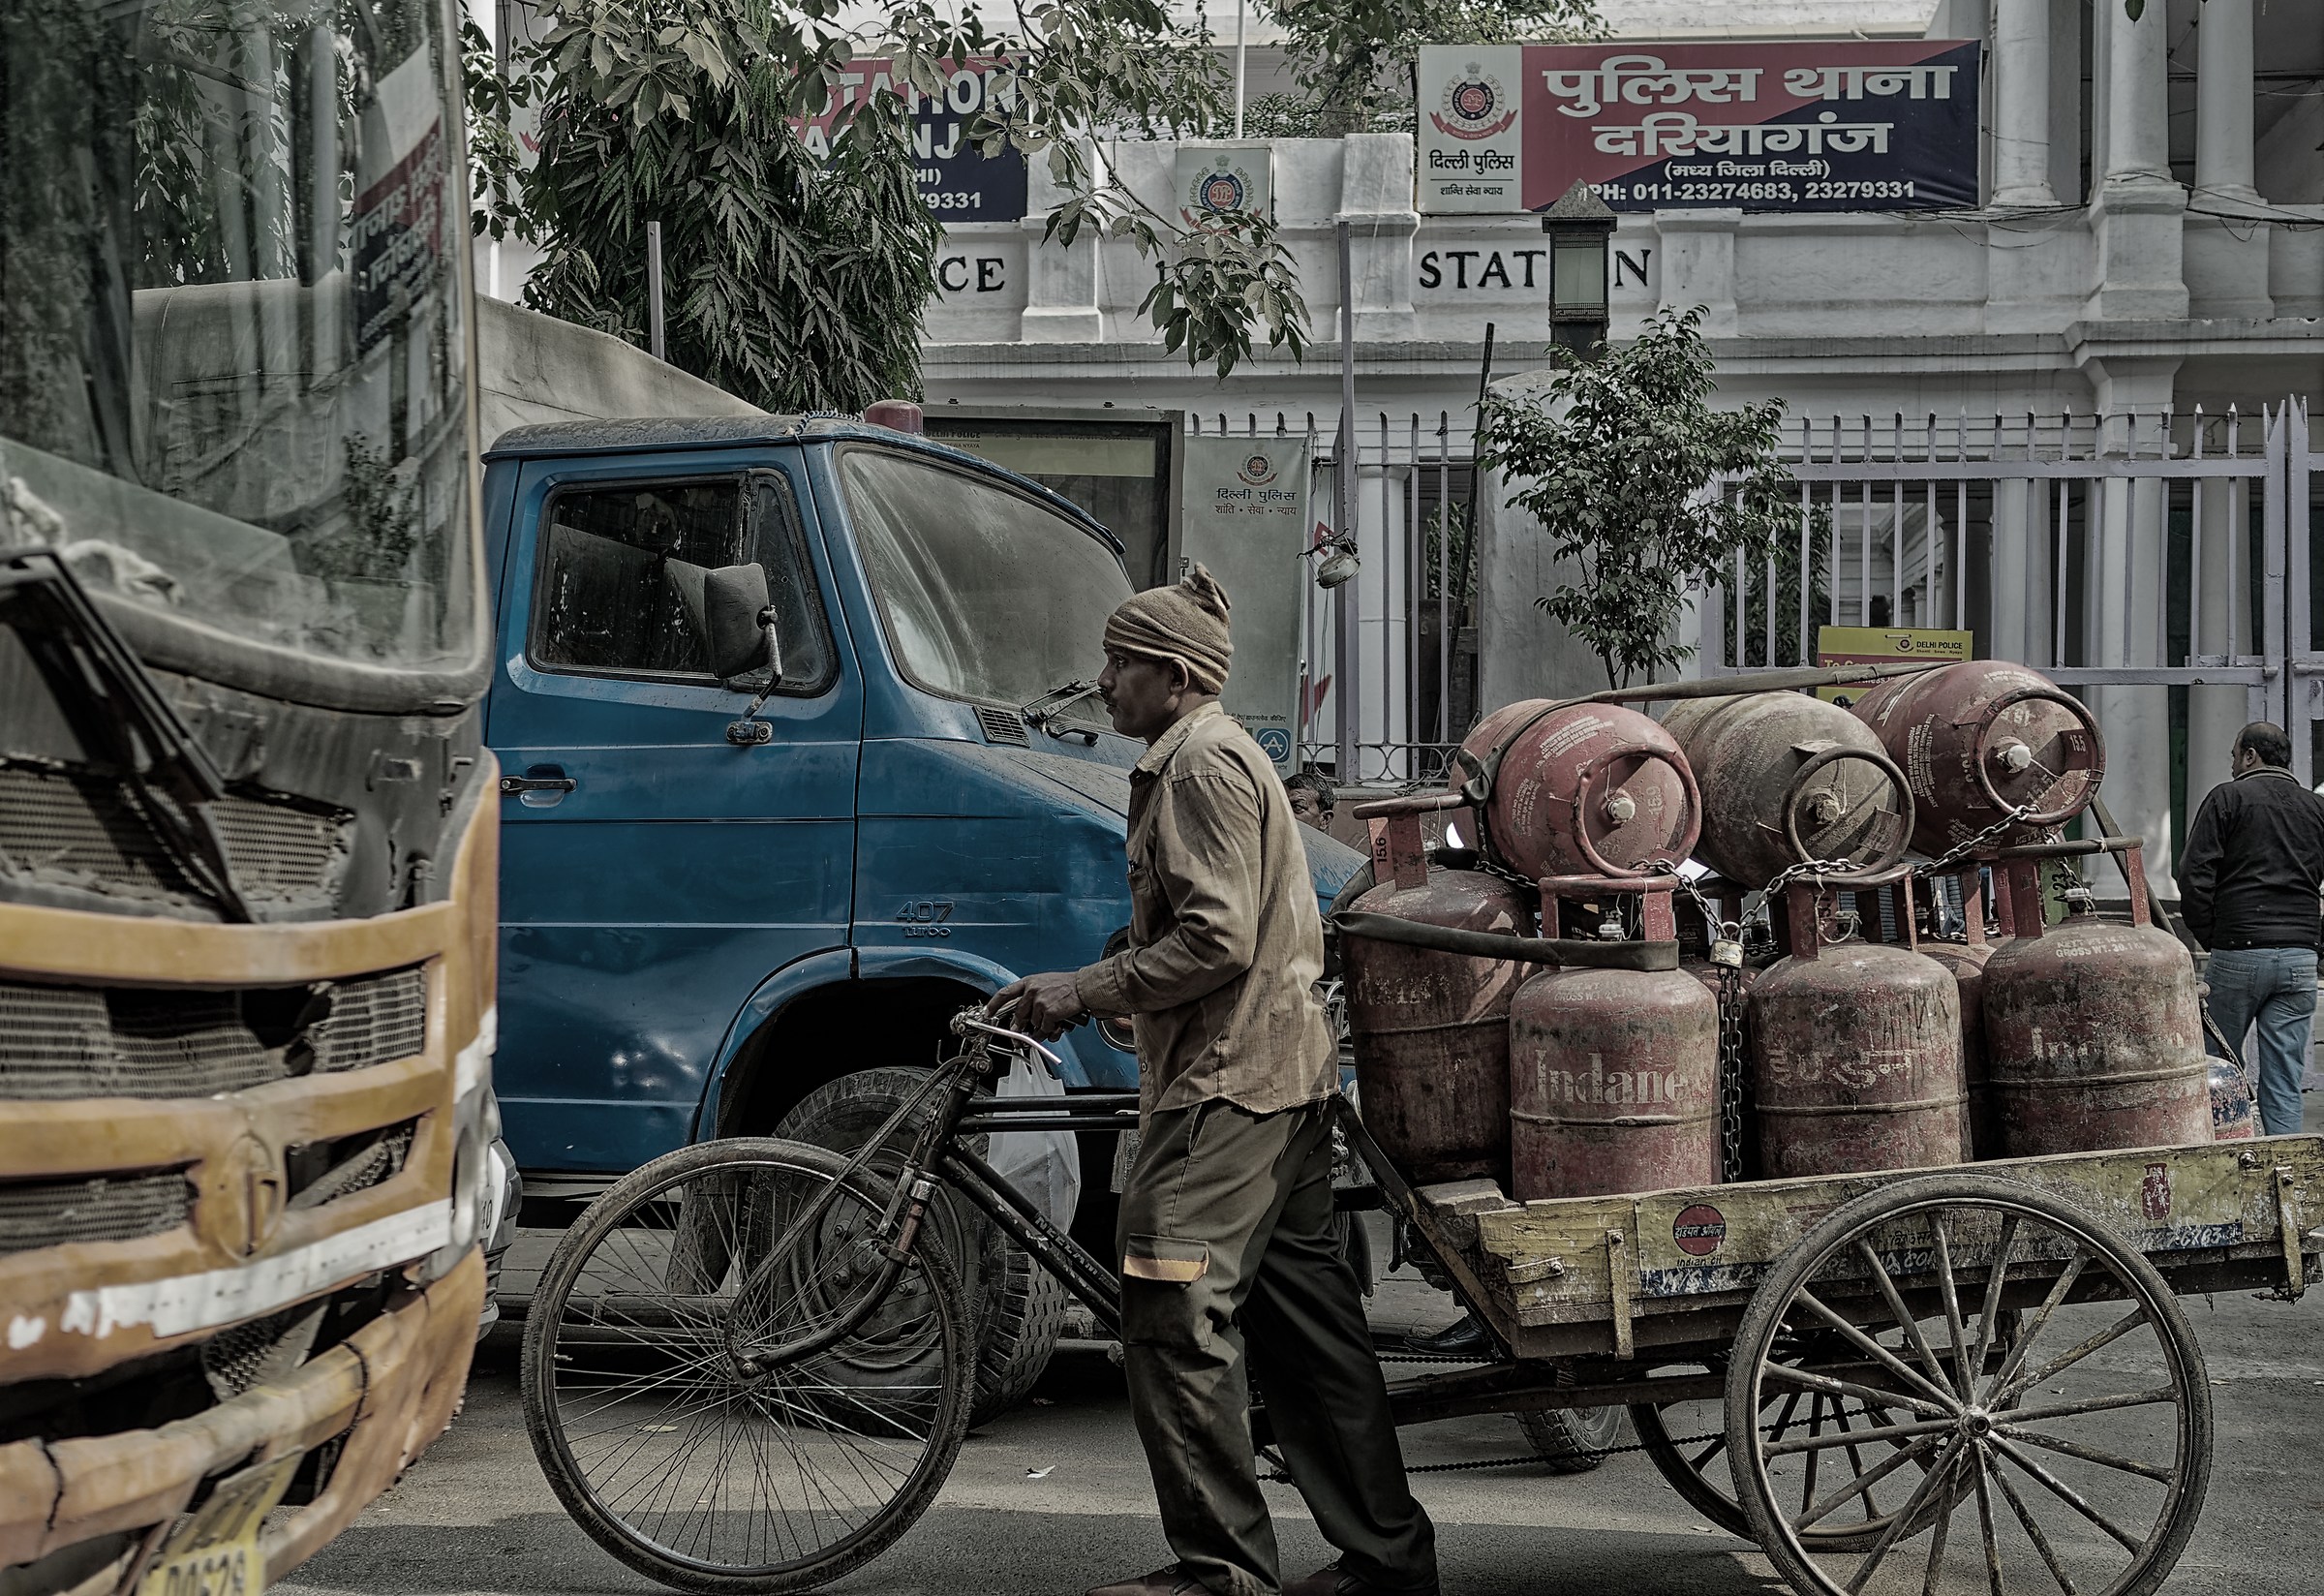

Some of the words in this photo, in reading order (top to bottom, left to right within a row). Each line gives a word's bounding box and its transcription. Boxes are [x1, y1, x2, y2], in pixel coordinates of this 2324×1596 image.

[1543, 55, 1763, 118] पुलिस
[1784, 65, 1959, 101] थाना
[1591, 111, 1894, 157] दरियागंज
[1429, 149, 1470, 169] दिल्ली
[1473, 149, 1514, 175] पुलिस
[1664, 162, 1711, 179] (मध्य
[1717, 161, 1765, 176] जिला
[1769, 160, 1830, 179] दिल्ली)
[1465, 184, 1482, 196] सेवा
[1633, 181, 1798, 203] 011-23274683,
[1805, 181, 1915, 200] 23279331
[1216, 488, 1252, 499] दिल्ली
[1259, 489, 1297, 503] पुलिस
[1247, 504, 1264, 514] सेवा
[1277, 506, 1297, 515] न्याय
[1939, 641, 1963, 650] POLICE
[1375, 837, 1387, 864] 15.6
[896, 901, 954, 923] 407
[2056, 948, 2092, 958] GROSS
[1535, 1050, 1690, 1104] Indane
[1034, 1215, 1099, 1275] NEELAM
